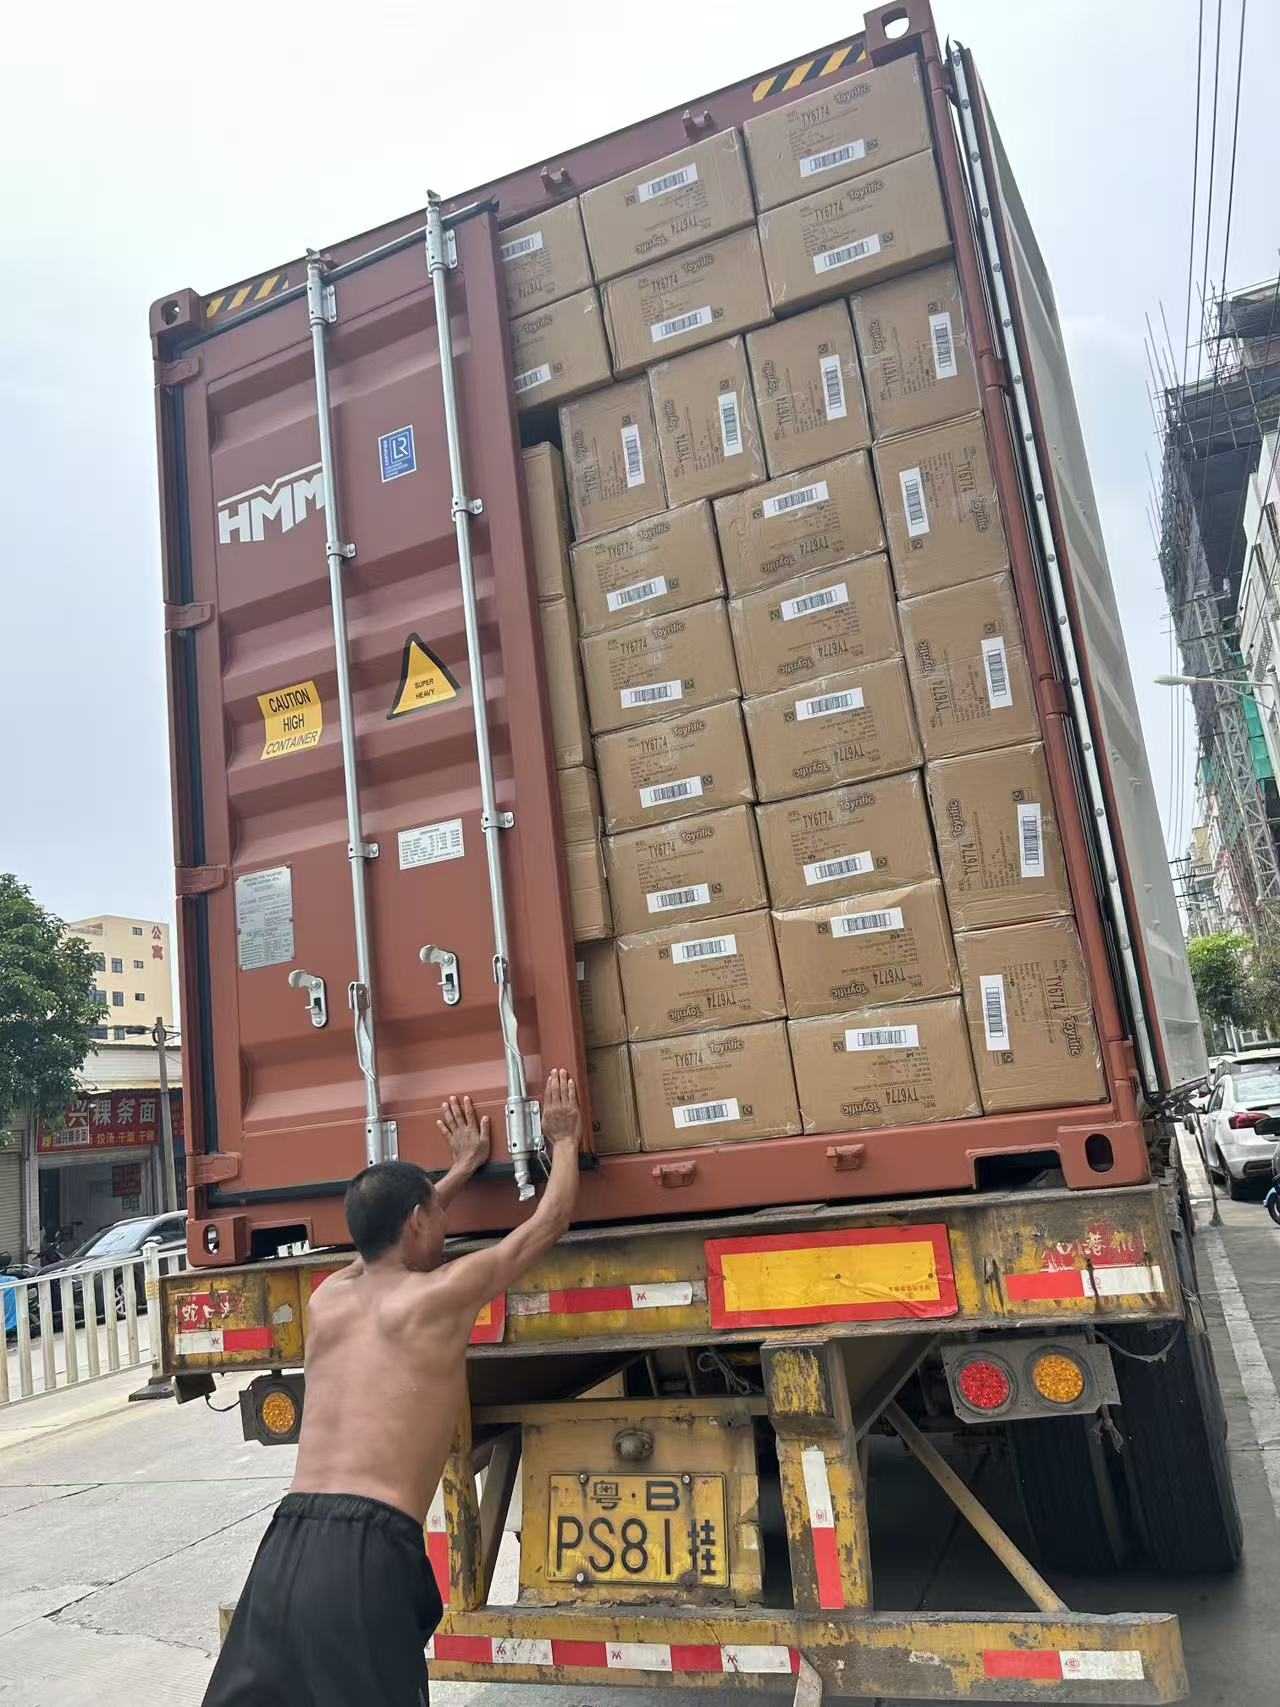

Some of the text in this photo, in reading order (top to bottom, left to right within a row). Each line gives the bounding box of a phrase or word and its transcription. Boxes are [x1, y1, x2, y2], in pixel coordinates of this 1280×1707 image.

[815, 202, 844, 222] TY6774
[956, 462, 976, 493] TY6774
[218, 472, 326, 545] HMM
[800, 535, 830, 556] TY6774
[620, 639, 648, 657] TY6774
[414, 678, 434, 690] SUPER
[415, 688, 435, 700] HEAVY
[268, 687, 312, 714] CAUTION
[930, 679, 948, 712] TY6774
[282, 713, 305, 733] HIGH
[265, 730, 318, 756] CONTAINER
[838, 793, 876, 812] Toyrific
[803, 810, 834, 830] TY6774
[947, 799, 964, 839] Toyrific
[679, 826, 714, 843] Toyrific
[648, 841, 677, 858] TY6774
[961, 842, 979, 877] TY6774
[872, 967, 906, 986] TY6774
[707, 991, 737, 1010] TY6774
[831, 982, 870, 1000] Toyrific
[1047, 975, 1066, 1011] TY6774
[1065, 1015, 1082, 1057] Toyrific
[674, 1050, 704, 1067] TY6774
[885, 1087, 920, 1104] TY6774
[840, 1099, 881, 1118] Toyrific
